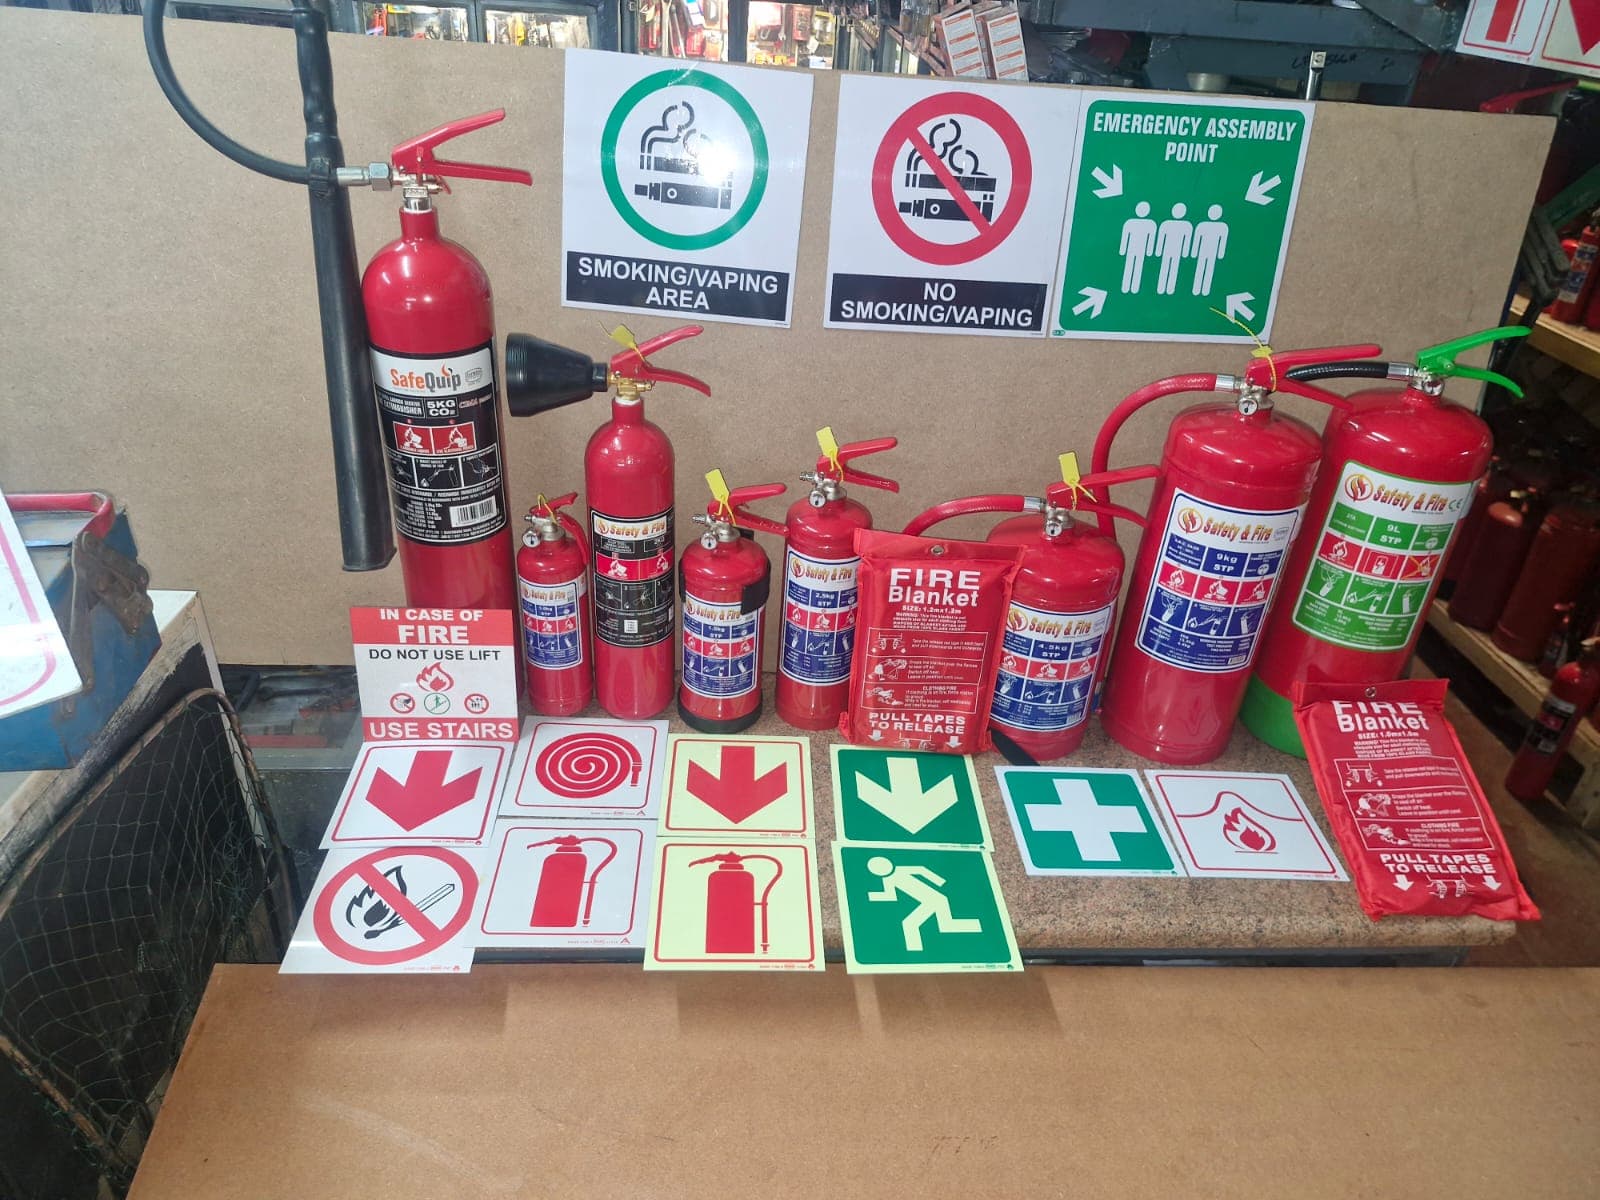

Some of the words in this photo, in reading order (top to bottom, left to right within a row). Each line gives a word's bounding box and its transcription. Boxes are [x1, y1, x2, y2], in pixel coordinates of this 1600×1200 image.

[1093, 112, 1202, 137] EMERGENCY
[1205, 117, 1297, 141] ASSEMBLY
[1165, 142, 1218, 163] POINT
[578, 257, 778, 294] SMOKING/VAPING
[646, 286, 710, 310] AREA
[923, 282, 956, 301] NO
[841, 300, 1033, 327] SMOKING/VAPING
[390, 364, 461, 392] SafeQuip
[427, 400, 456, 409] 5KG
[1373, 483, 1414, 511] Safety
[1414, 492, 1425, 510] &
[1425, 494, 1449, 512] Fire
[610, 523, 640, 538] Safety
[1203, 517, 1241, 543] Safety
[1240, 524, 1252, 540] &
[1251, 525, 1274, 541] Fire
[1387, 524, 1401, 533] 9L
[1380, 535, 1402, 545] STP
[1216, 553, 1238, 564] 9kg
[1213, 564, 1235, 573] STP
[890, 568, 981, 591] FIRE
[888, 585, 979, 607] Blanket
[380, 609, 400, 621] IN
[405, 609, 454, 622] CASE
[459, 609, 484, 622] OF
[397, 625, 470, 644] FIRE
[1029, 617, 1063, 639] Safety
[1063, 620, 1073, 636] &
[1073, 620, 1092, 636] Fire
[369, 649, 392, 660] DO
[397, 649, 428, 660] NOT
[433, 649, 465, 661] USE
[469, 650, 501, 661] LIFT
[1332, 700, 1423, 715] FIRE
[869, 712, 910, 722] PULL
[913, 713, 966, 726] TAPES
[869, 720, 890, 730] TO
[893, 722, 966, 735] RELEASE
[1336, 713, 1430, 733] Blanket
[369, 722, 419, 739] USE
[427, 722, 514, 739] STAIRS
[1380, 853, 1428, 864] PULL
[1428, 854, 1491, 864] TAPES
[1384, 863, 1410, 873] TO
[1413, 864, 1497, 874] RELEASE
